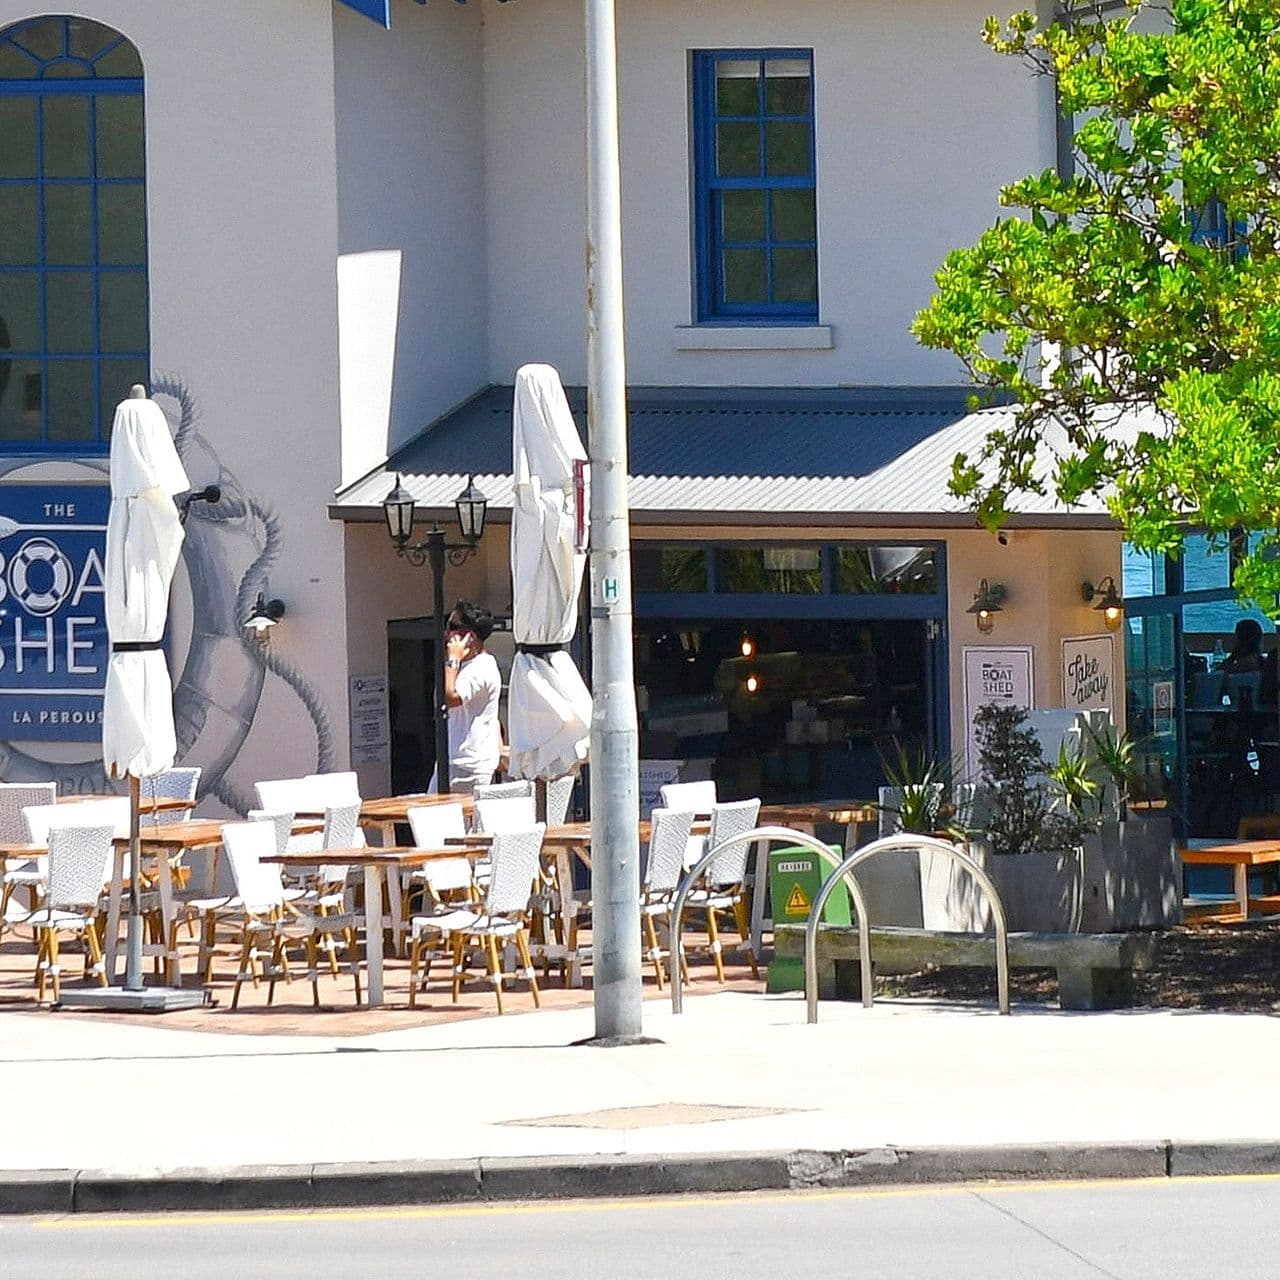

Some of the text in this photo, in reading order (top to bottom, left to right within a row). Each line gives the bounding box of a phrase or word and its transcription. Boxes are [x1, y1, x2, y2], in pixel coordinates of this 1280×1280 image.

[43, 503, 76, 517] THE
[605, 578, 617, 598] H
[982, 669, 1013, 681] BOAT
[1068, 653, 1099, 697] Take
[982, 682, 1014, 693] SHED
[1077, 673, 1109, 704] away
[12, 711, 104, 724] LA PEROUS
